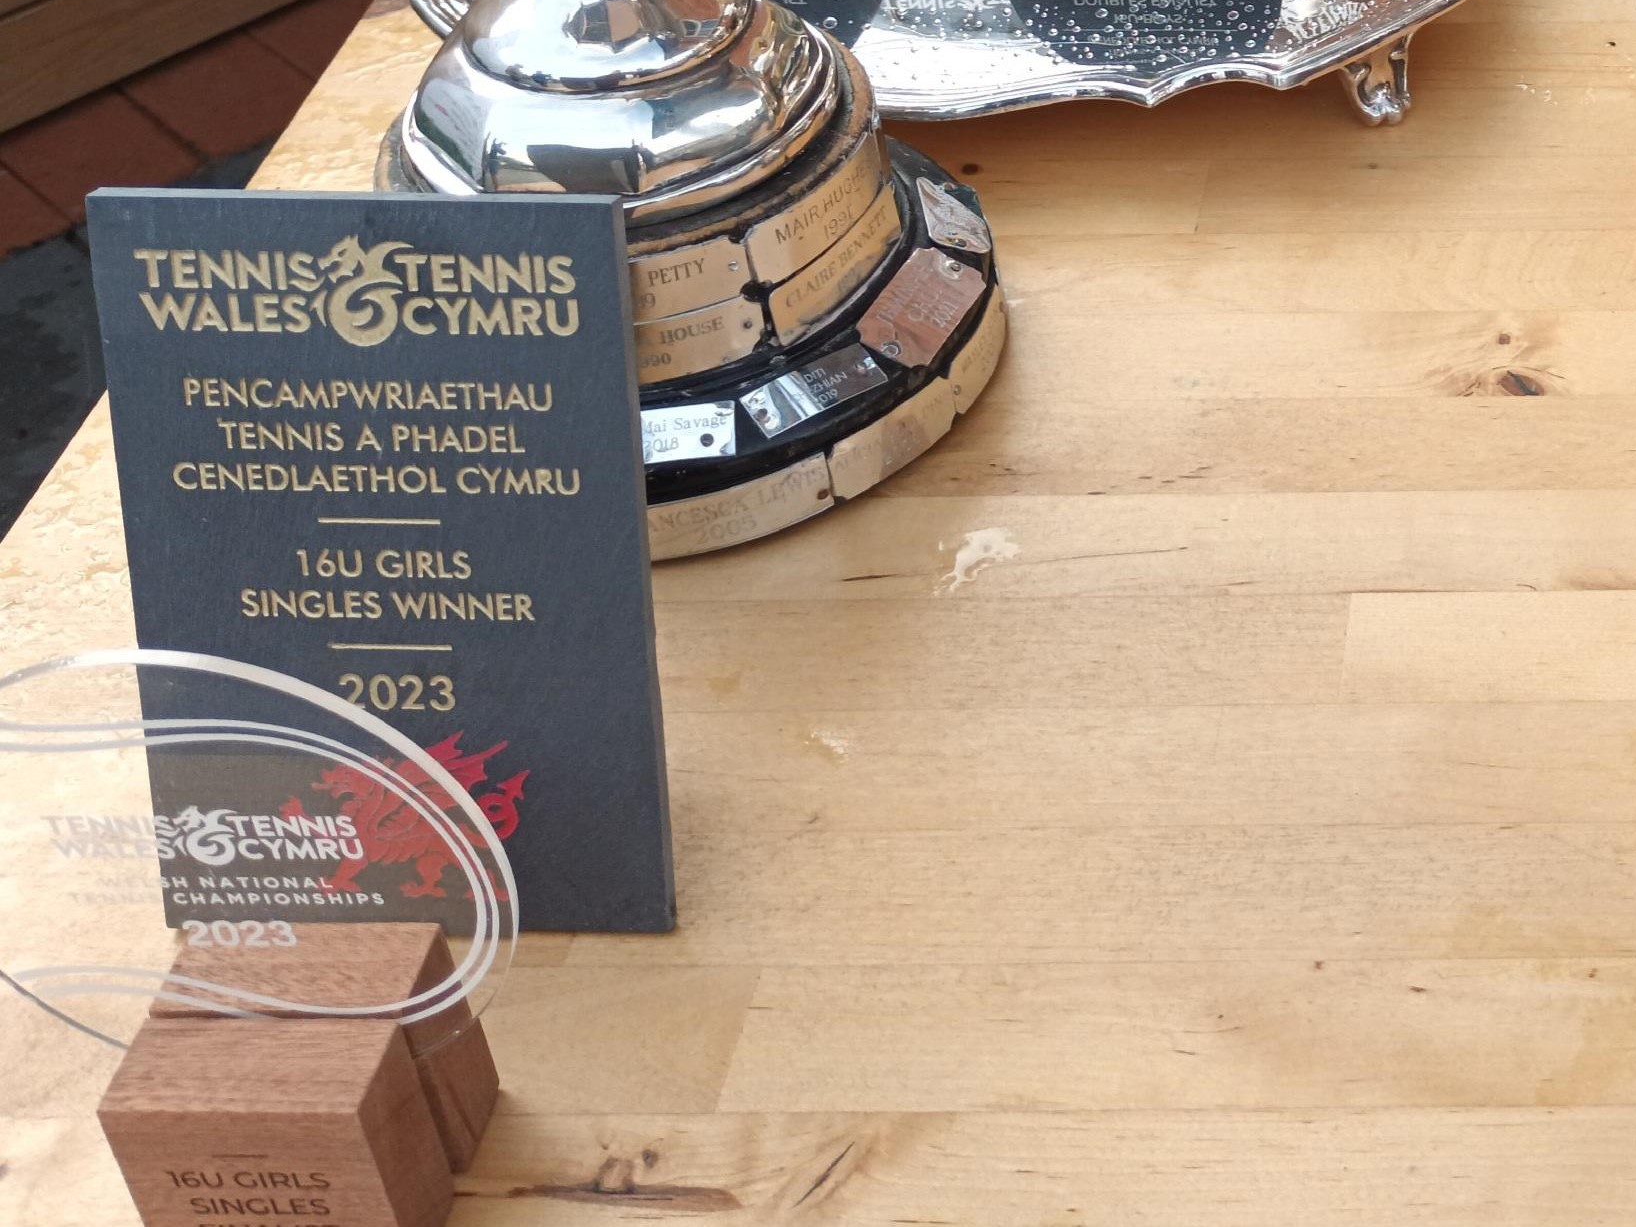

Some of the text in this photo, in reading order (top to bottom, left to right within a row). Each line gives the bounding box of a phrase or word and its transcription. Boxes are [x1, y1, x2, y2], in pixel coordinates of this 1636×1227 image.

[775, 205, 822, 245] MAIR
[134, 249, 577, 295] TENNIS TENNIS
[647, 258, 706, 288] PETTY
[137, 292, 580, 337] WALES CYMRU
[659, 317, 726, 346] HOUSE
[183, 377, 554, 412] PENCAMPWRIAETHAU
[217, 418, 526, 455] TENNIS A PHADEL
[673, 413, 728, 433] Savage
[172, 461, 582, 496] CENEDLAETHOL CYMRU
[295, 549, 472, 580] 16U GIRLS
[240, 590, 536, 622] SINGLES WINNER
[339, 674, 457, 712] 2023
[225, 815, 358, 837] TENNIS
[237, 838, 364, 860] CYMRU
[200, 876, 334, 890] NATIONAL
[173, 893, 386, 906] CHAMPIONSHIPS
[182, 919, 298, 948] 2023
[164, 1171, 331, 1190] 16U GIRLS
[190, 1197, 332, 1216] SINGLES
